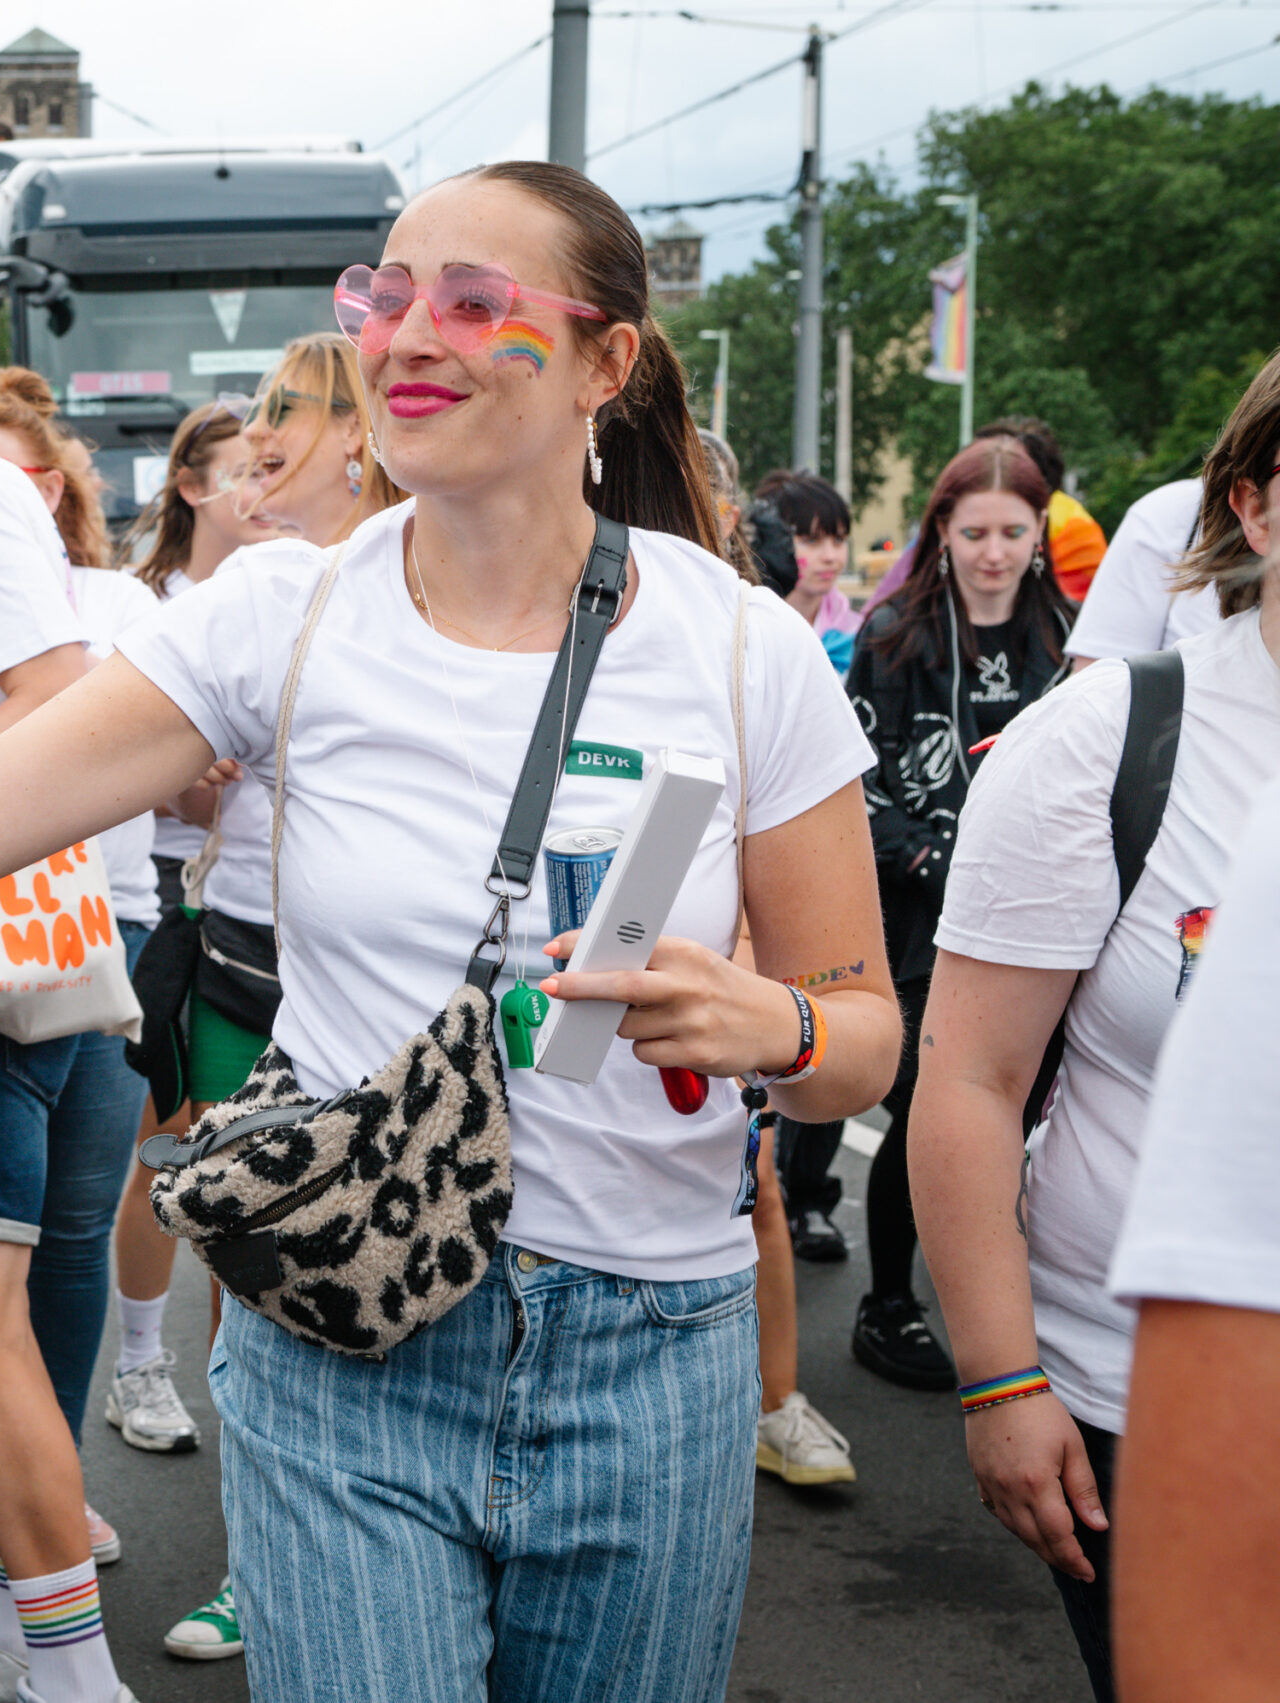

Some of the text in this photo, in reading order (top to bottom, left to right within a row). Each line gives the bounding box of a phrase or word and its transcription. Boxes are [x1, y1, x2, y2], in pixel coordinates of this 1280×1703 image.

[578, 751, 631, 768] DEVK
[19, 979, 31, 993] IN
[35, 975, 92, 994] DIVERSITY
[782, 966, 848, 989] RIDE
[530, 994, 542, 1021] DEVK
[803, 1019, 811, 1043] FÜR
